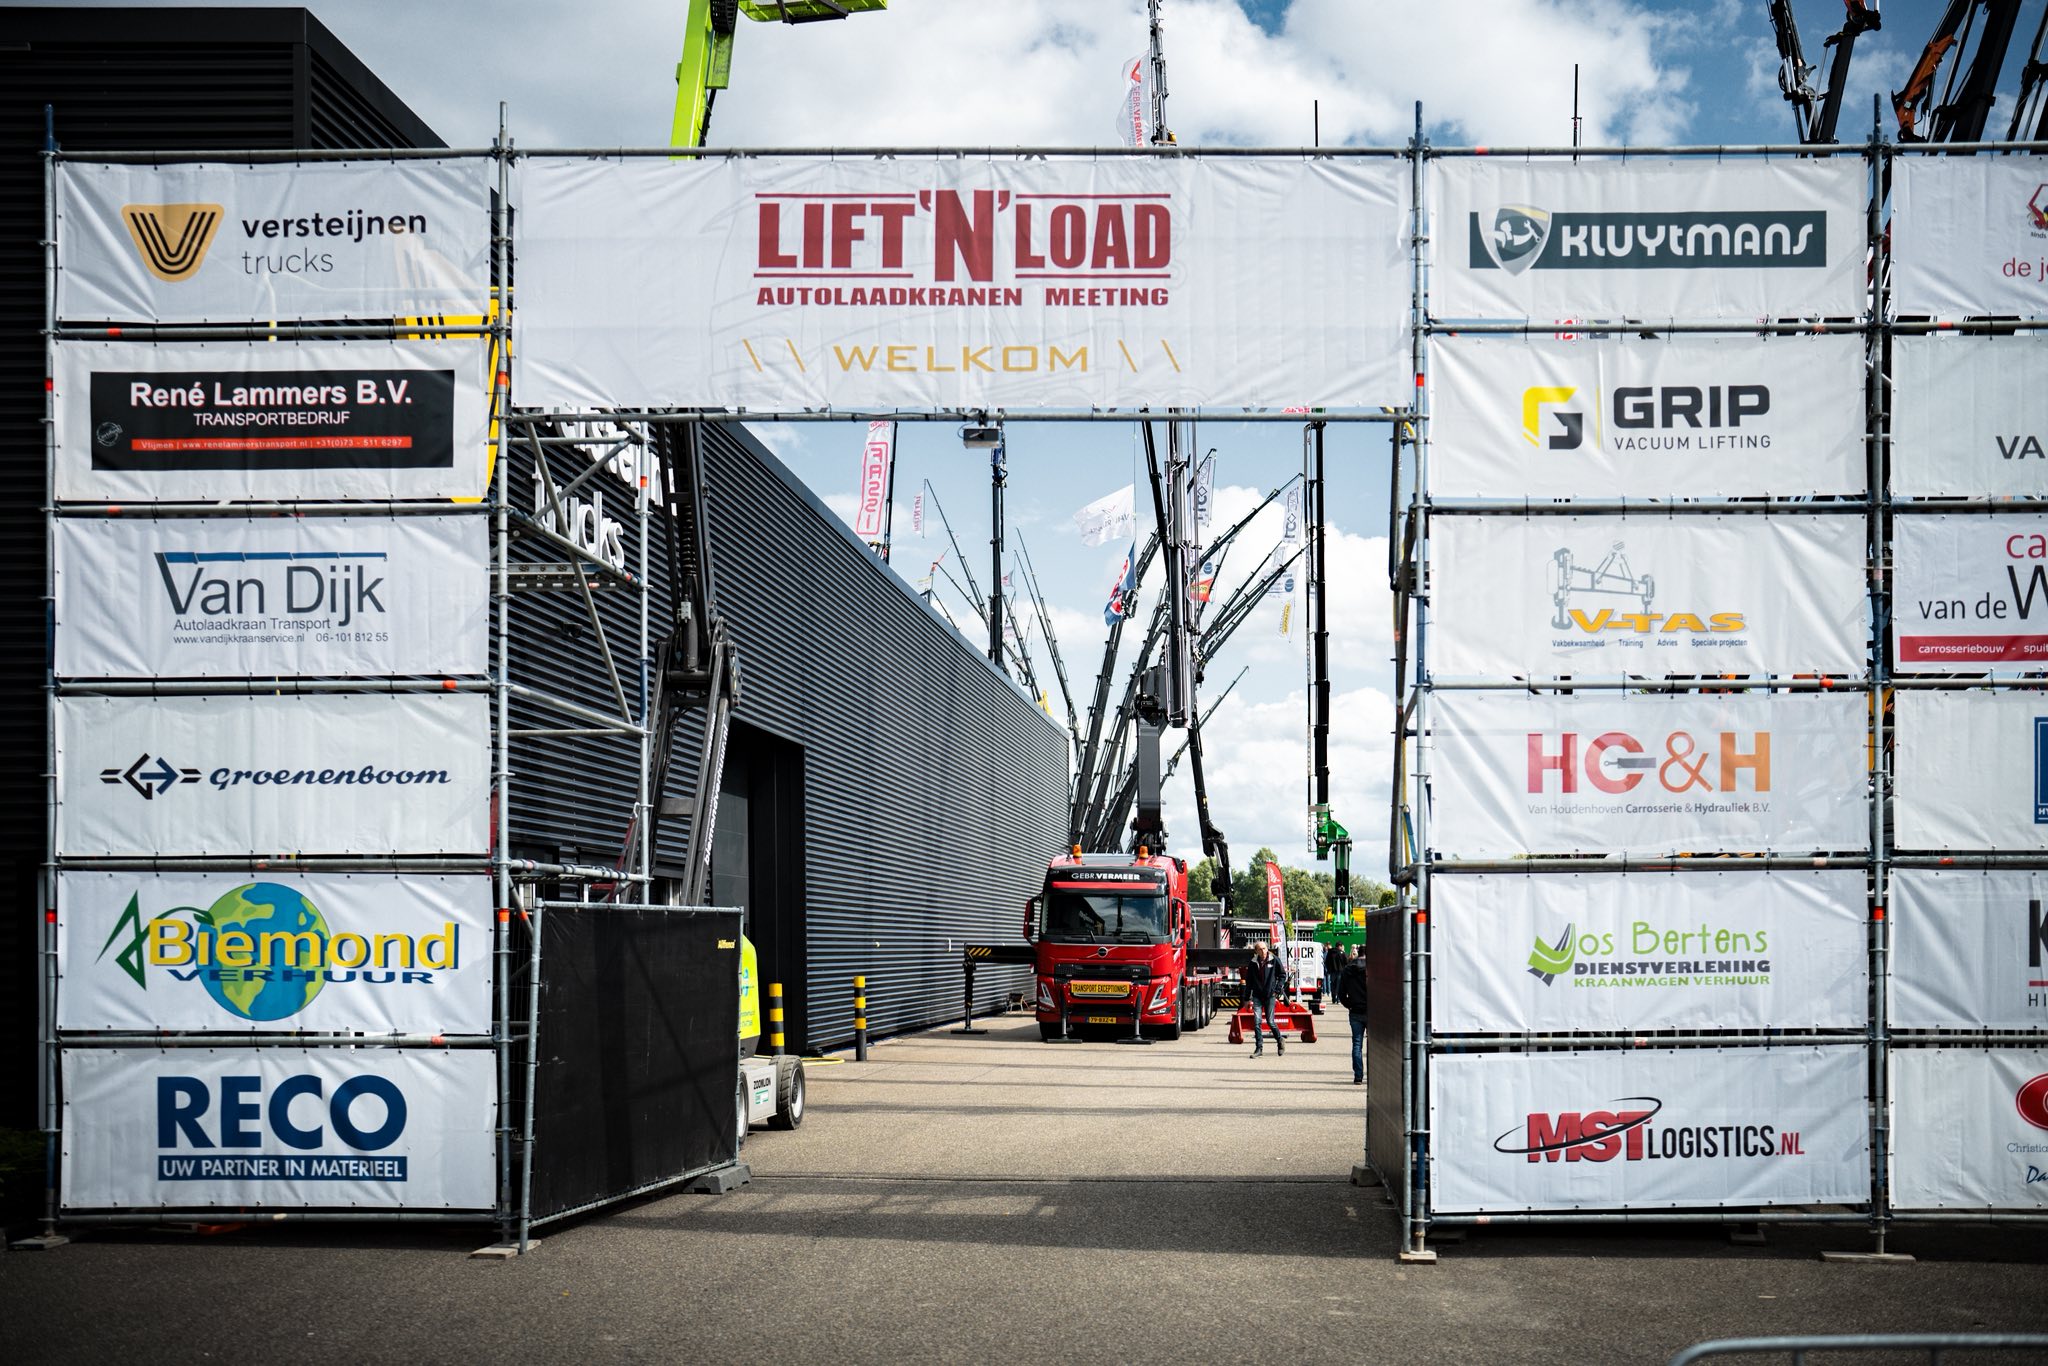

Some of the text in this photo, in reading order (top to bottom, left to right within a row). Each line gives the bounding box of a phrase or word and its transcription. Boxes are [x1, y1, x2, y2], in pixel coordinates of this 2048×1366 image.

[242, 209, 427, 242] versteijnen
[243, 248, 334, 275] trucks
[2002, 256, 2048, 282] de j
[756, 287, 1169, 306] AUTOLAADKRANEN MEETING
[833, 345, 1088, 373] WELKOM
[130, 379, 413, 407] René Lammers B.V.
[1613, 384, 1771, 429] GRIP
[193, 410, 350, 426] TRANSPORTBEDRIJF
[142, 441, 174, 450] Vlijmen
[1614, 434, 1771, 451] VACUUM LIFTING
[154, 552, 386, 628] Van Dijk
[1918, 599, 1966, 619] van
[1975, 591, 2007, 619] de
[173, 617, 331, 632] Autolaadkraan Transport
[1568, 607, 1750, 634] V-TAS
[173, 633, 305, 645] www.vandijkkraanservice.nl
[354, 632, 373, 642] 812
[375, 632, 389, 641] 55
[1618, 639, 1644, 649] Training
[1657, 638, 1678, 647] Advies
[1691, 637, 1717, 647] Speciale
[1918, 644, 2004, 654] carrosseriebouw
[209, 765, 451, 791] Groenenboom
[1528, 803, 1548, 814] Van
[1550, 802, 1624, 814] Houdenhoven
[1626, 802, 1682, 813] Carrosserie
[1695, 801, 1750, 814] Hydrauliek
[1752, 801, 1771, 812] B.V.
[149, 918, 459, 969] Biemond
[1632, 921, 1768, 955] Bertens
[167, 968, 434, 985] VERHUUR
[1574, 960, 1771, 975] DIENSTVERLENING
[1072, 984, 1097, 992] TRANSPORT
[1574, 975, 1770, 988] KRAANWAGEN VERHUUR
[157, 1074, 407, 1151] RECO
[162, 1159, 403, 1178] UW PARTNER IN MATERIEEL
